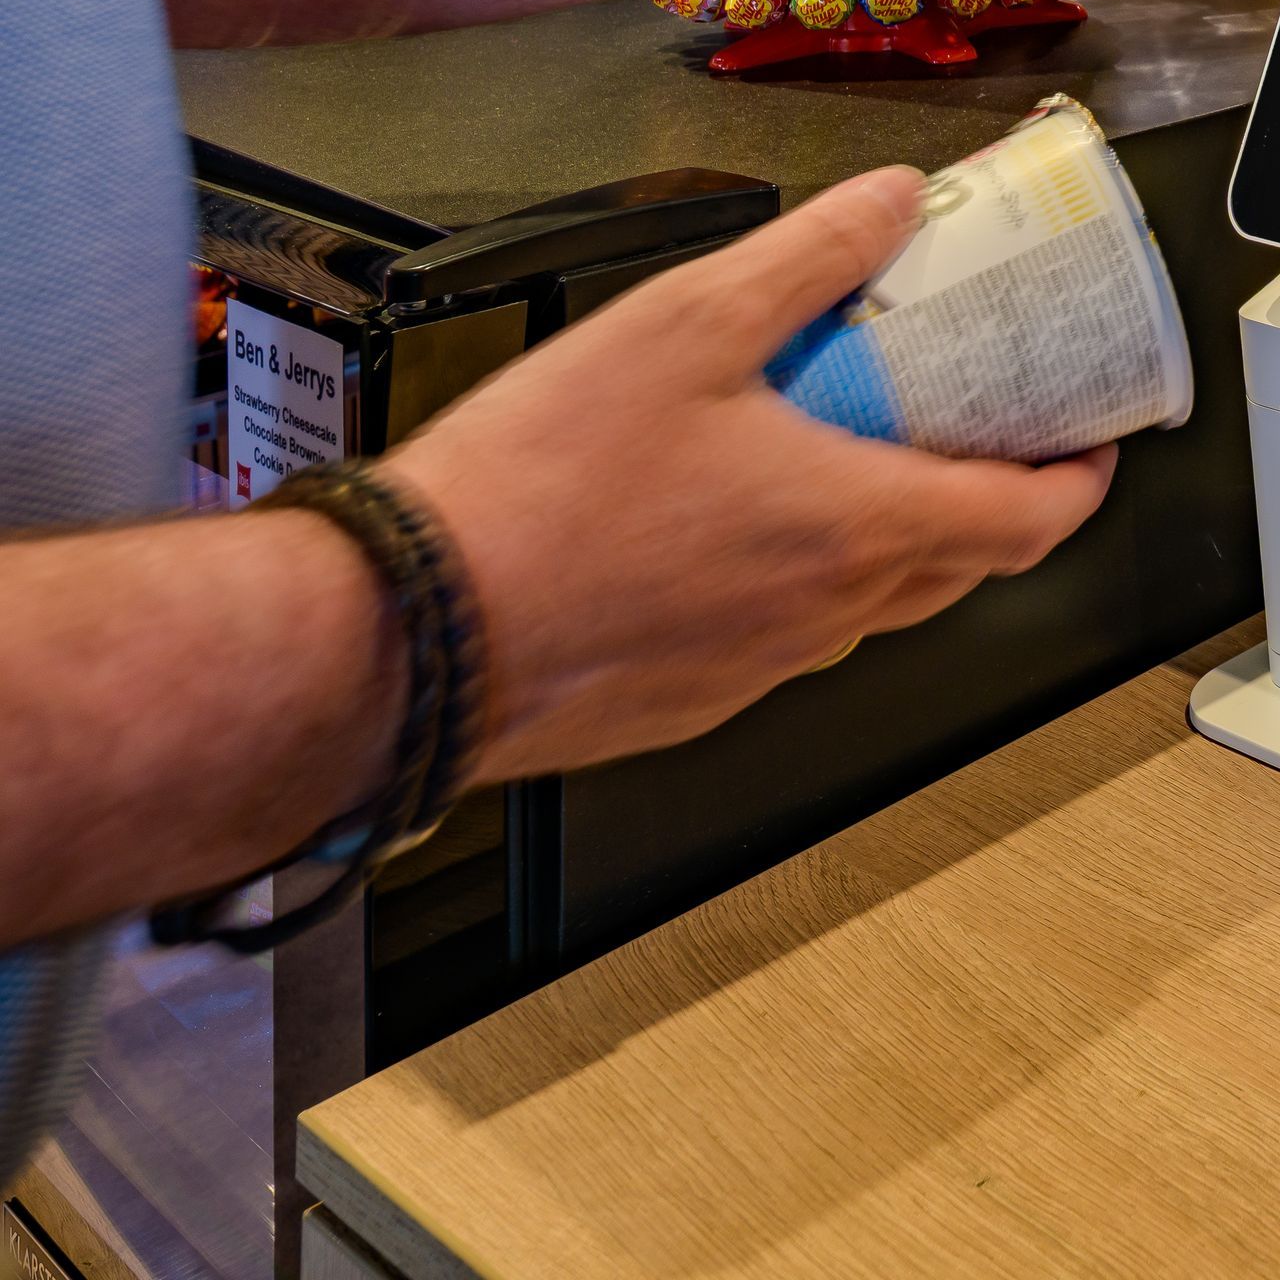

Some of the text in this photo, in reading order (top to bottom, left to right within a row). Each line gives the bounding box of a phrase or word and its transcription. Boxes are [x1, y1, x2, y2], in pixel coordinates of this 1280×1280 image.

[235, 329, 335, 401] Ben & Jerrys
[234, 385, 337, 446] Strawberry Cheesecake
[244, 415, 287, 451] Chocolate
[254, 447, 284, 476] Cookie
[9, 1226, 57, 1280] KLARS
